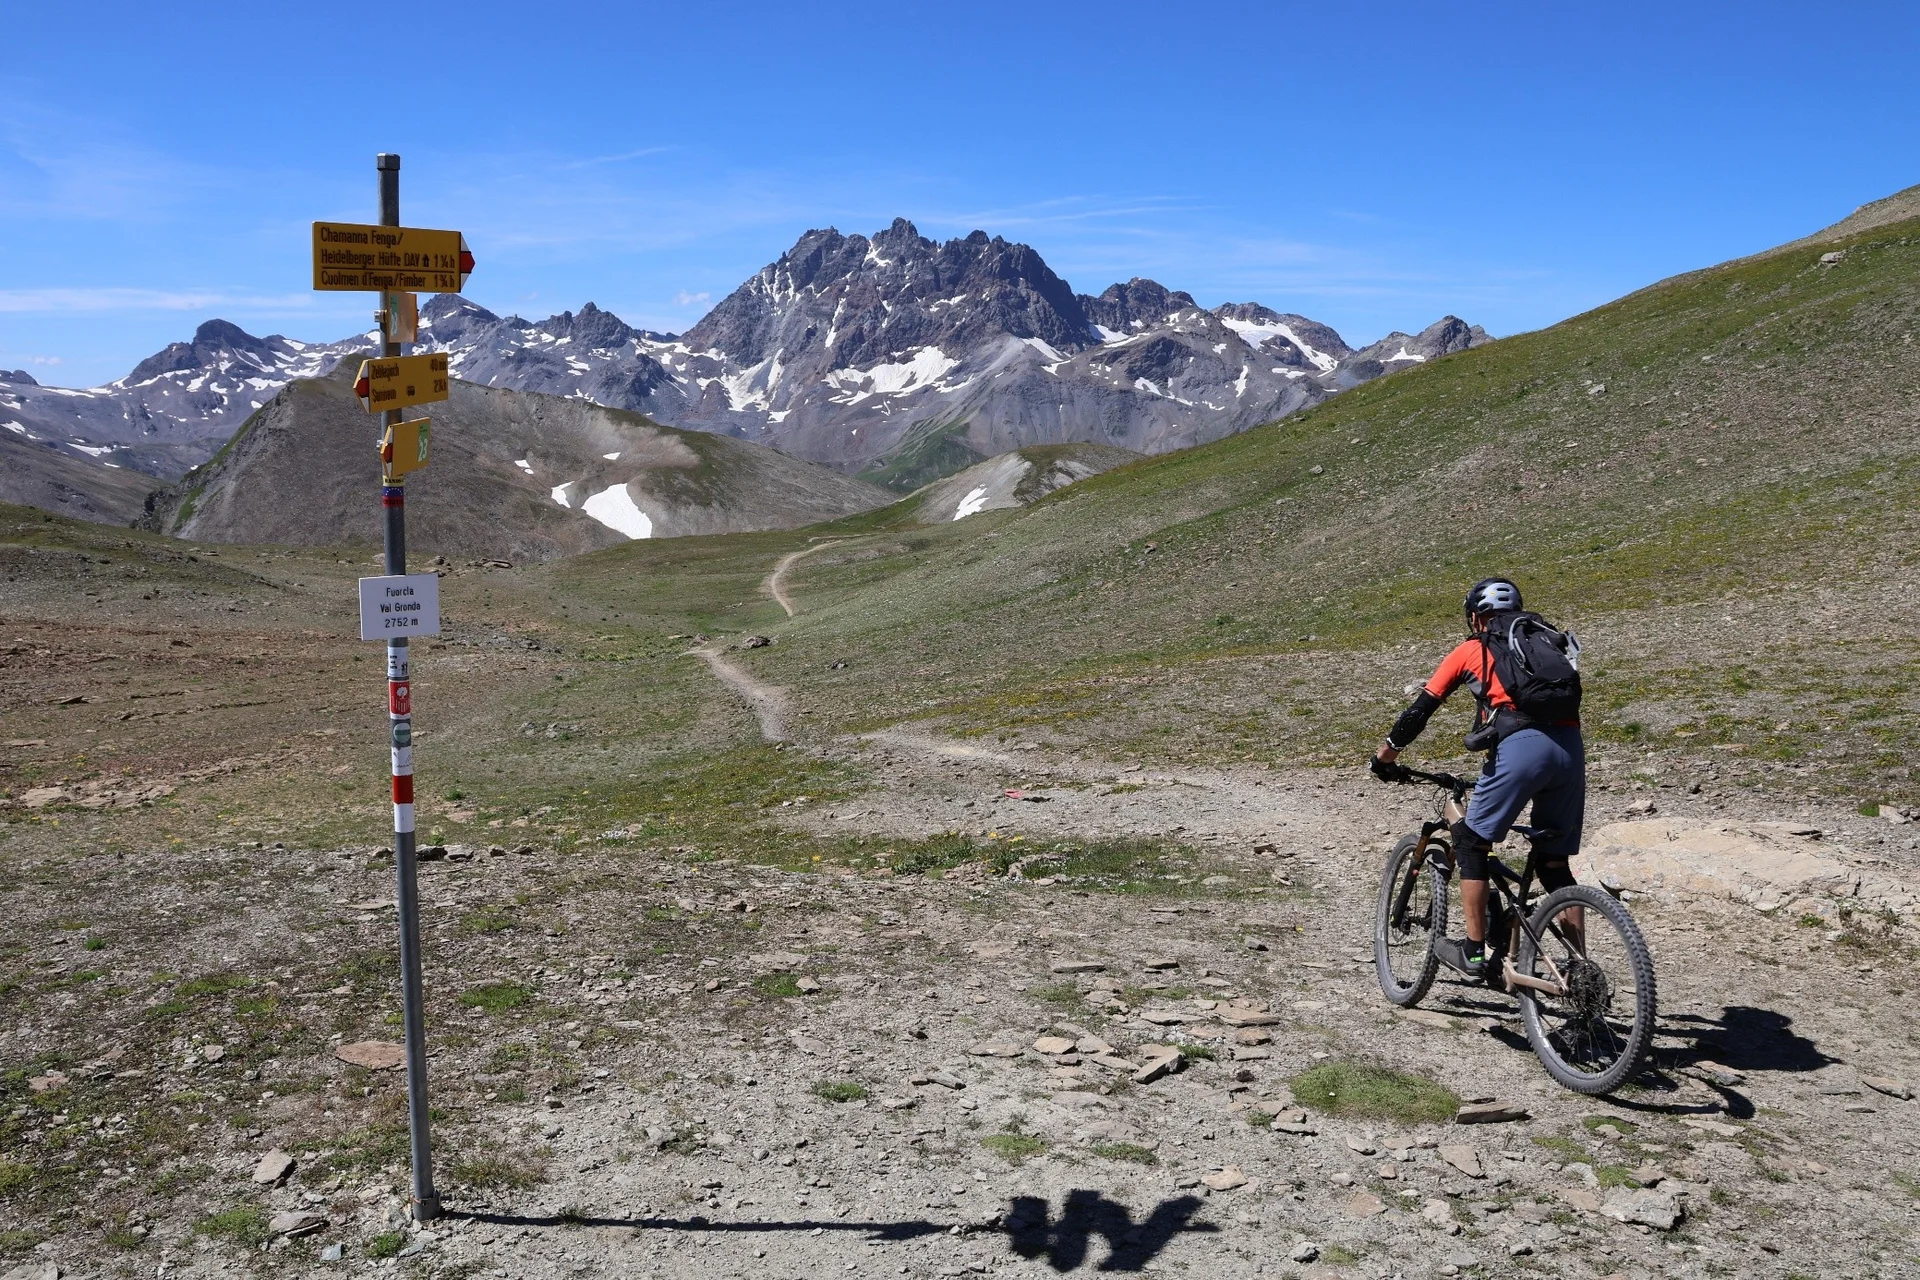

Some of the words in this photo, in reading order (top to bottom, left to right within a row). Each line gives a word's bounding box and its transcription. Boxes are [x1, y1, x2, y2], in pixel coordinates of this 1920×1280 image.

[321, 226, 368, 245] Chamanna
[371, 230, 404, 249] Fenga/
[321, 248, 376, 269] Heidelberger
[378, 251, 401, 267] Hütte
[404, 252, 421, 267] DAV
[321, 270, 359, 287] Cuolmen
[386, 586, 414, 597] Fuorcla
[380, 603, 392, 613] Val
[394, 601, 421, 612] Gronda
[384, 617, 408, 629] 2752
[411, 618, 419, 626] m
